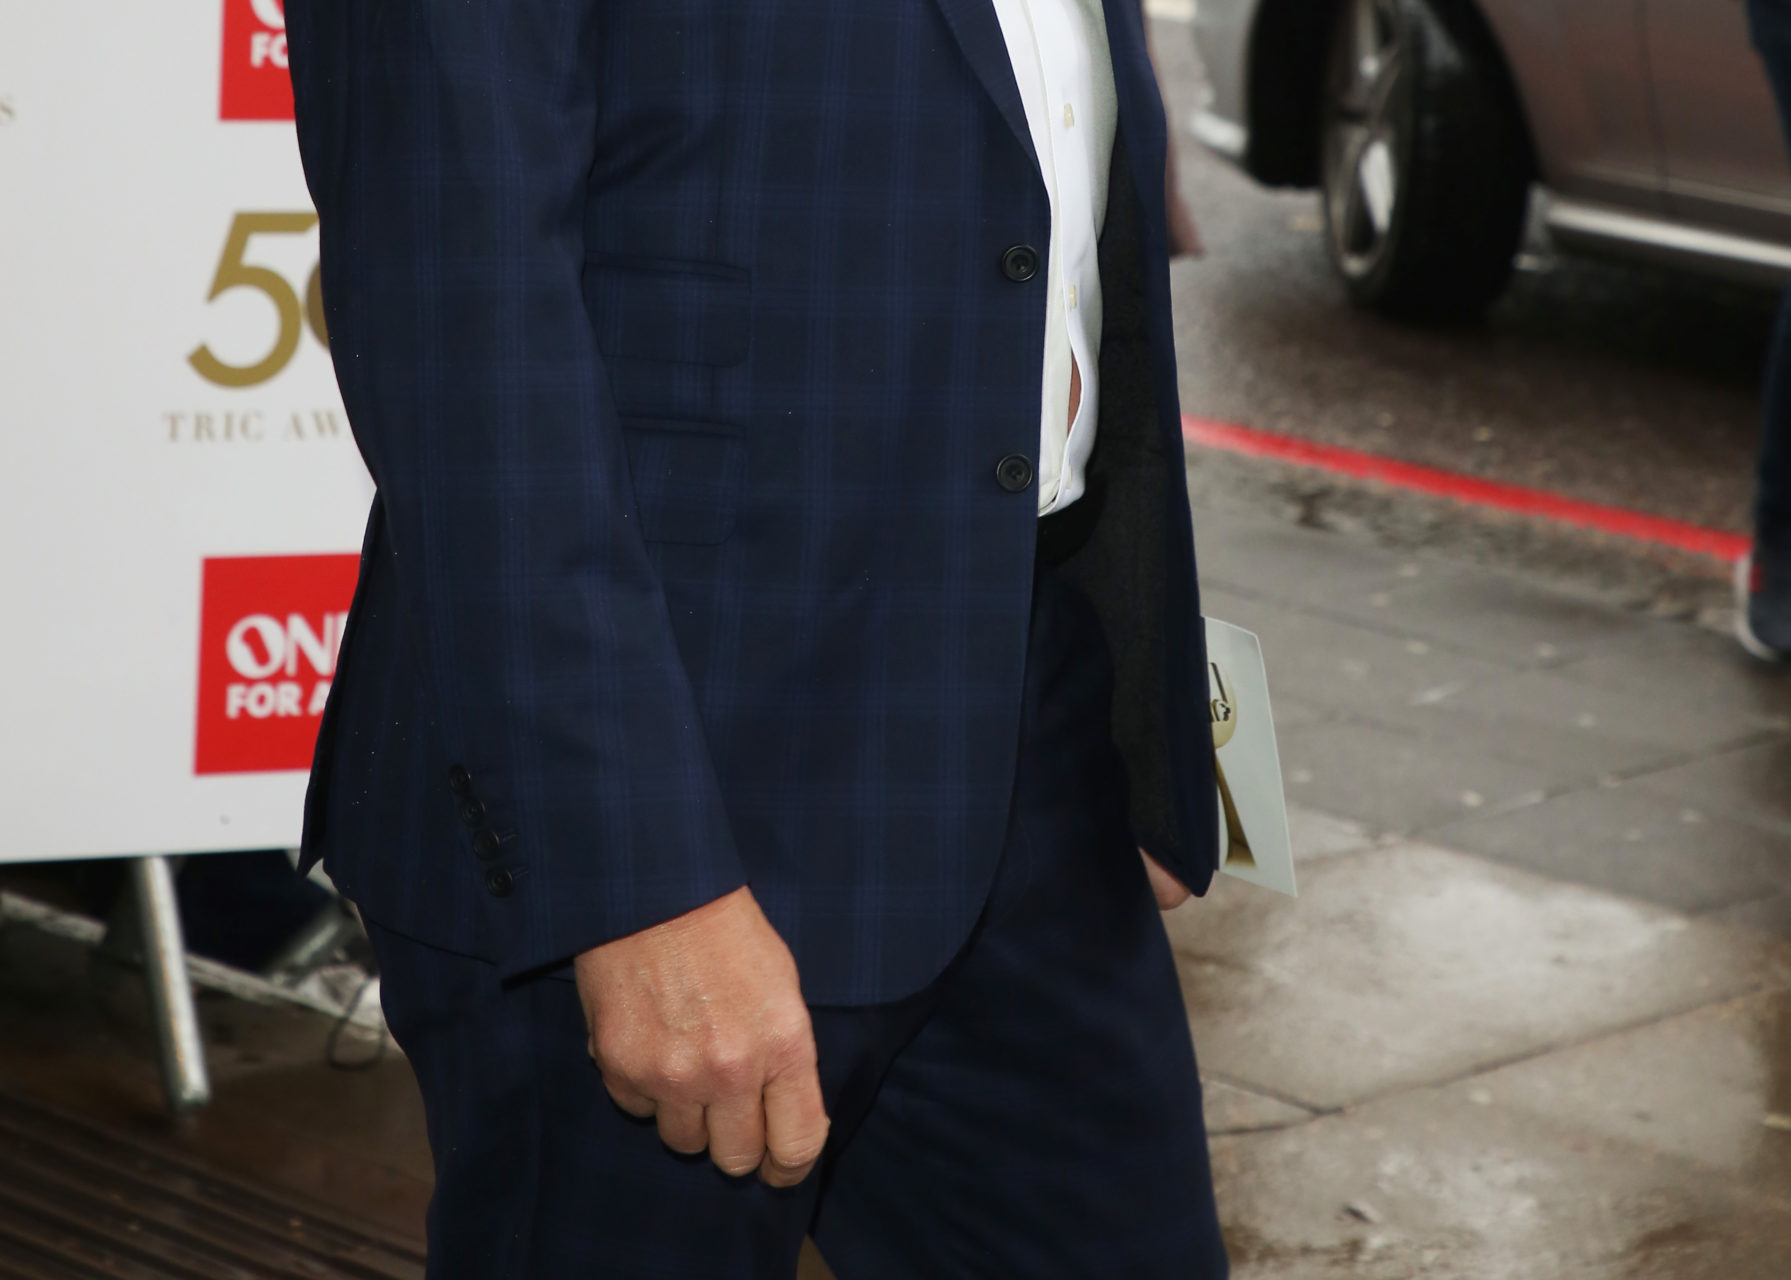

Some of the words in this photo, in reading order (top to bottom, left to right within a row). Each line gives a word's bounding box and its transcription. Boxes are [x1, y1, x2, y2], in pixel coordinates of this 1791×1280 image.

[251, 32, 290, 68] FO
[187, 211, 332, 390] 5
[161, 410, 263, 442] TRIC
[283, 409, 342, 441] AW
[226, 681, 301, 719] FOR
[307, 679, 333, 716] A
